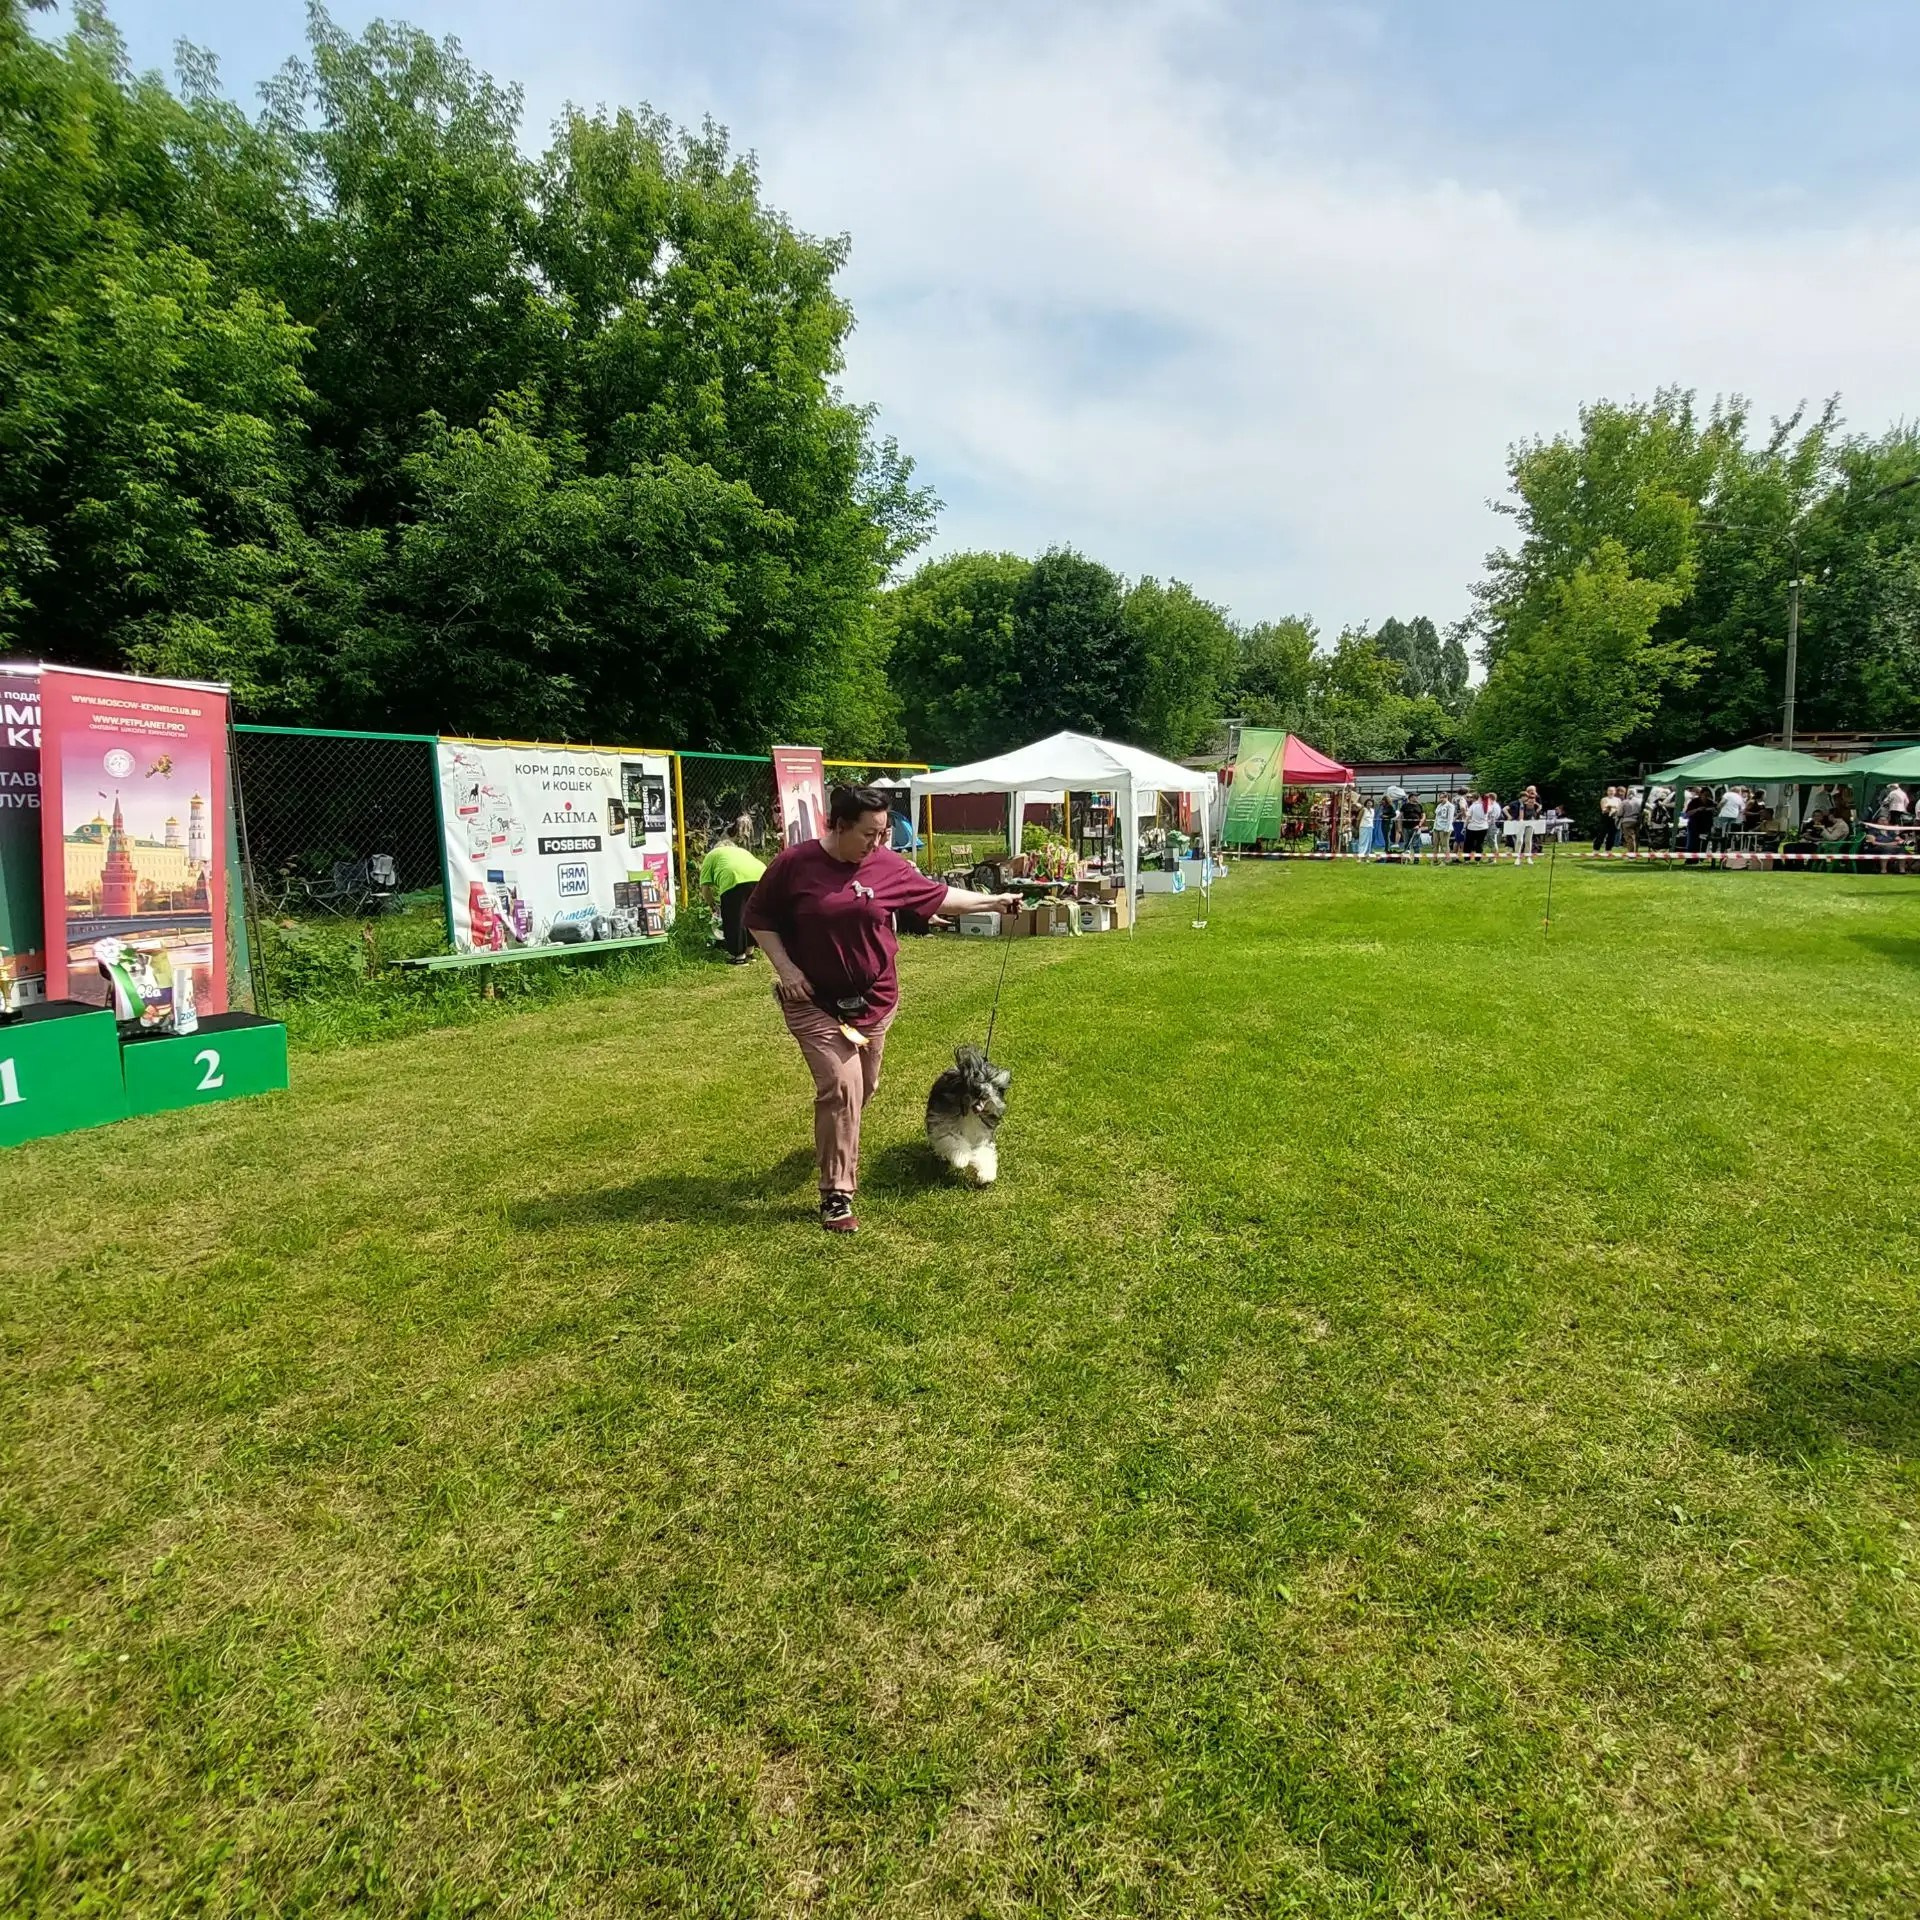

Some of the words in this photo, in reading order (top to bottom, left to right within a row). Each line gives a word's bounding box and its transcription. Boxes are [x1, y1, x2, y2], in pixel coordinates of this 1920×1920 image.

[92, 714, 186, 731] WWW.PETPLANET.PRO
[515, 764, 549, 776] КОРМ
[552, 765, 576, 777] ДЛЯ
[578, 767, 613, 777] СОБАК
[0, 772, 42, 787] ТАВ
[542, 781, 550, 791] И
[553, 781, 592, 792] КОШЕК
[541, 811, 598, 824] AKIMA
[544, 839, 596, 852] FOSBERG
[561, 867, 586, 879] НЯМ
[562, 881, 587, 892] НЯМ
[194, 1049, 224, 1091] 2
[0, 1057, 27, 1105] 1
